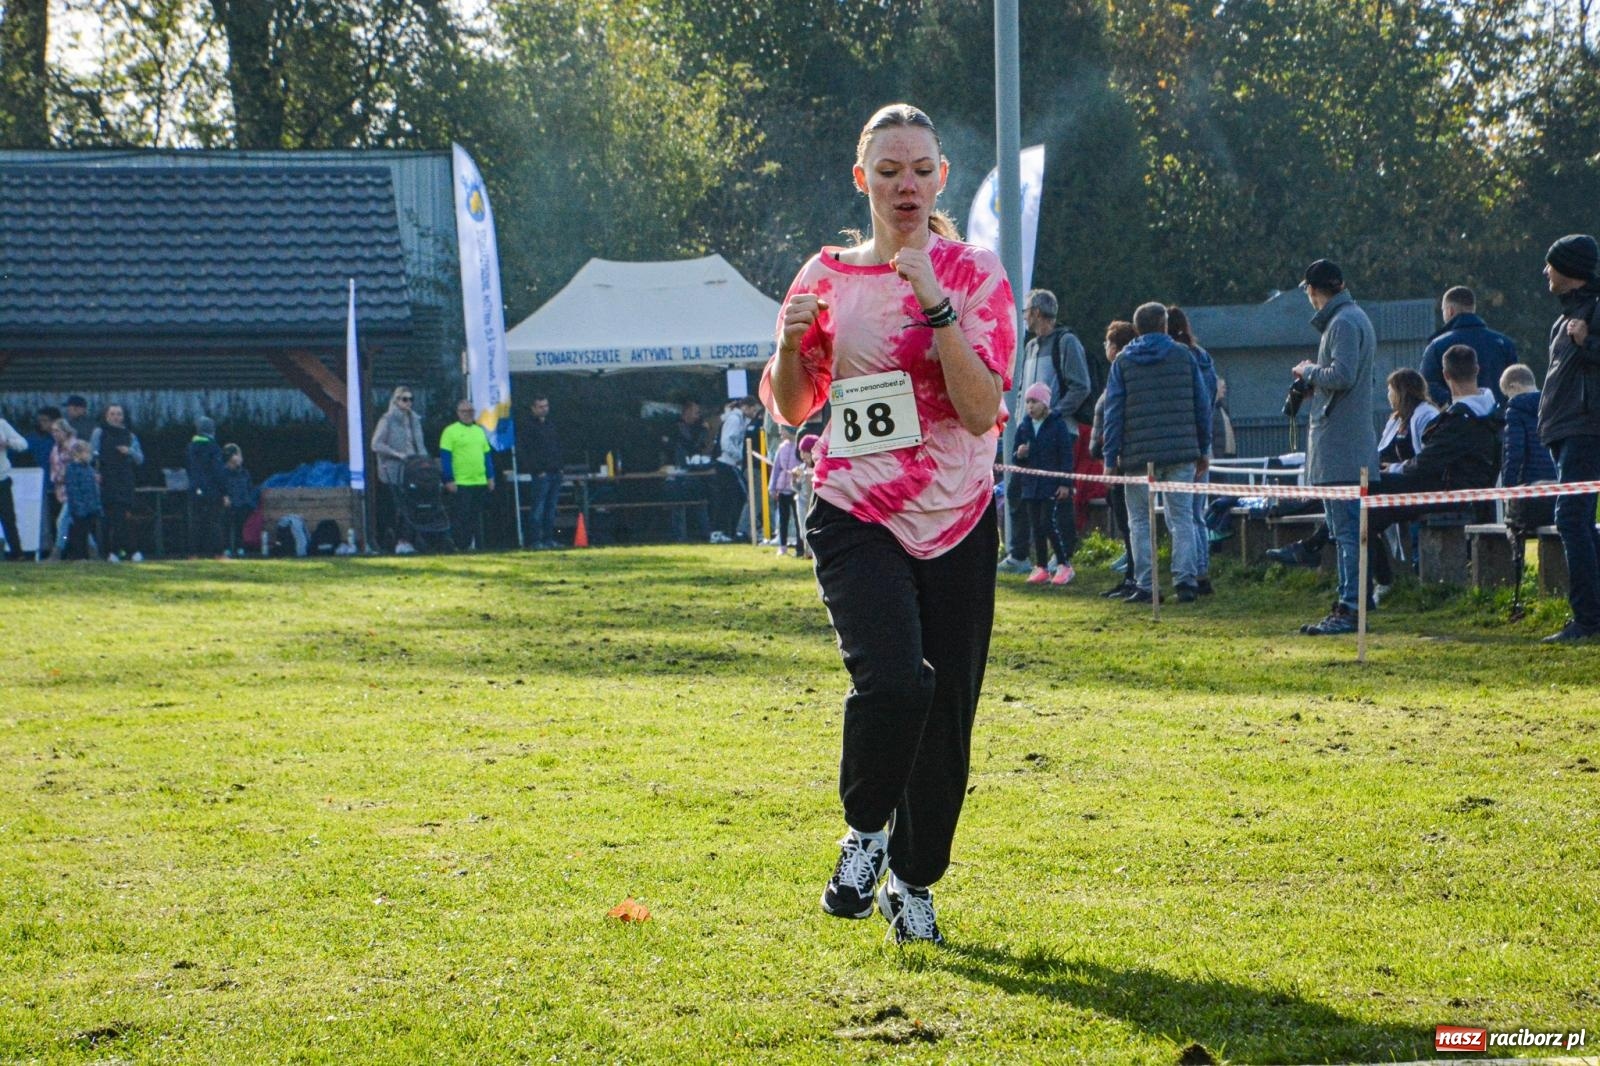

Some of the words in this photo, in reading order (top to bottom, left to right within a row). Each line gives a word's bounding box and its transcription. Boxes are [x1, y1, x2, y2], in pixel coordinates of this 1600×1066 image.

[535, 348, 620, 366] STOWARZYSZENIE
[631, 346, 673, 361] AKTYWNI
[682, 346, 701, 360] DLA
[710, 344, 758, 359] LEPSZEGO
[845, 379, 906, 394] www.personalbest.pl
[843, 402, 895, 443] 88
